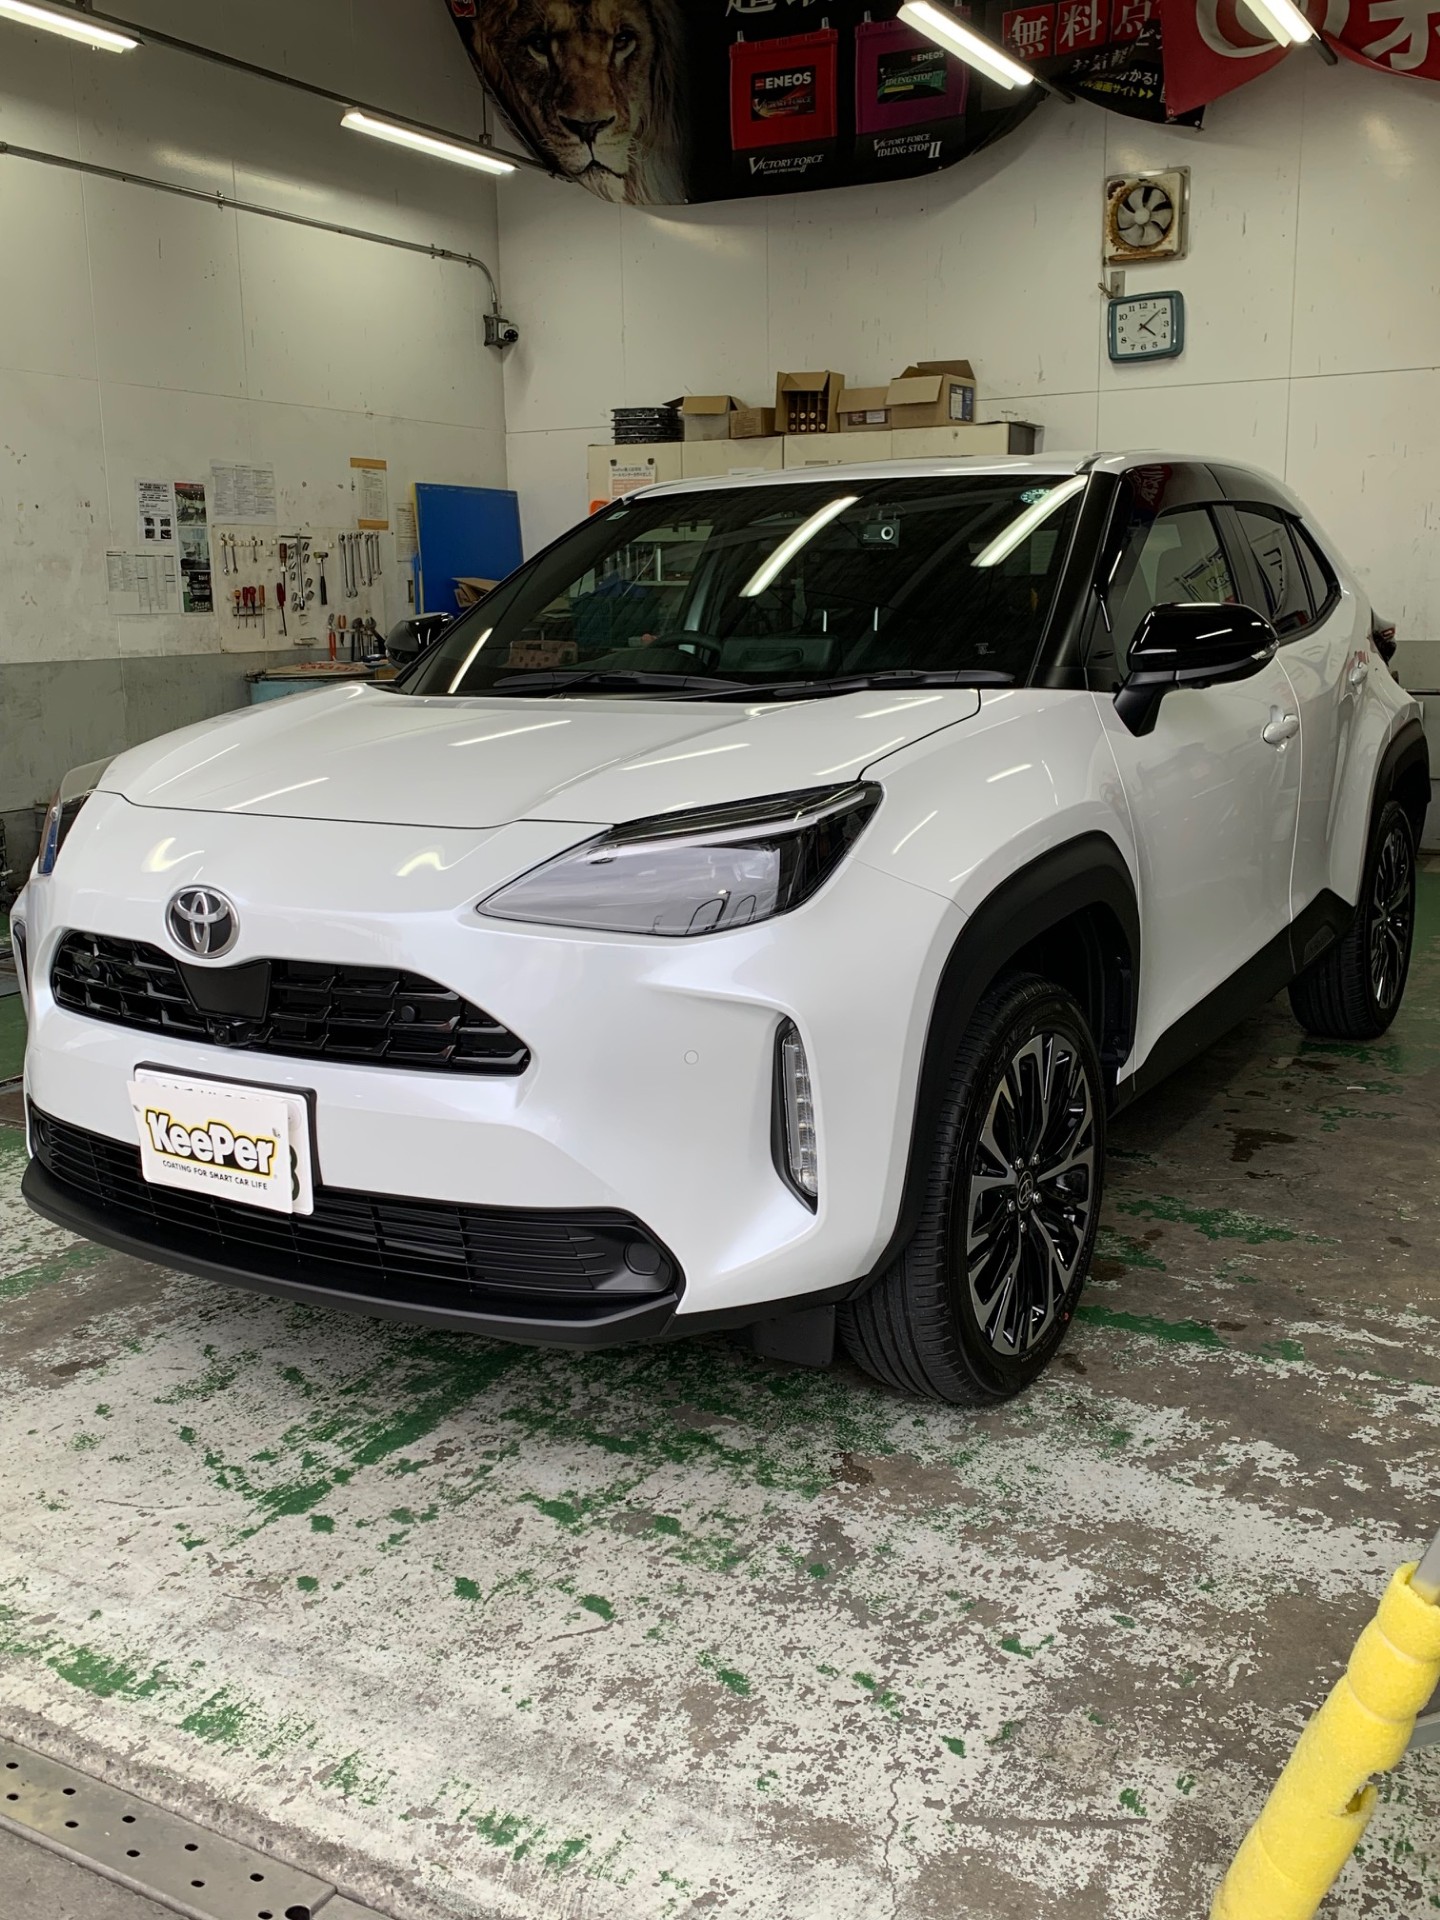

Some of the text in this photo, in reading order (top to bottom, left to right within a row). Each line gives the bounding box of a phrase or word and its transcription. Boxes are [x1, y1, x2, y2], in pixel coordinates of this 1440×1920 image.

[917, 50, 944, 62] ENEOS
[764, 71, 813, 90] ENEOS
[872, 133, 931, 151] VICTORY FORCE
[877, 145, 906, 157] IDLING
[907, 142, 930, 153] STOP
[749, 154, 824, 175] VICTORY FORCE
[1139, 302, 1148, 310] 12
[1153, 302, 1157, 310] 1
[145, 1109, 276, 1176] KeePer
[162, 1160, 268, 1190] COATING FOR SMART CAR LIFE
